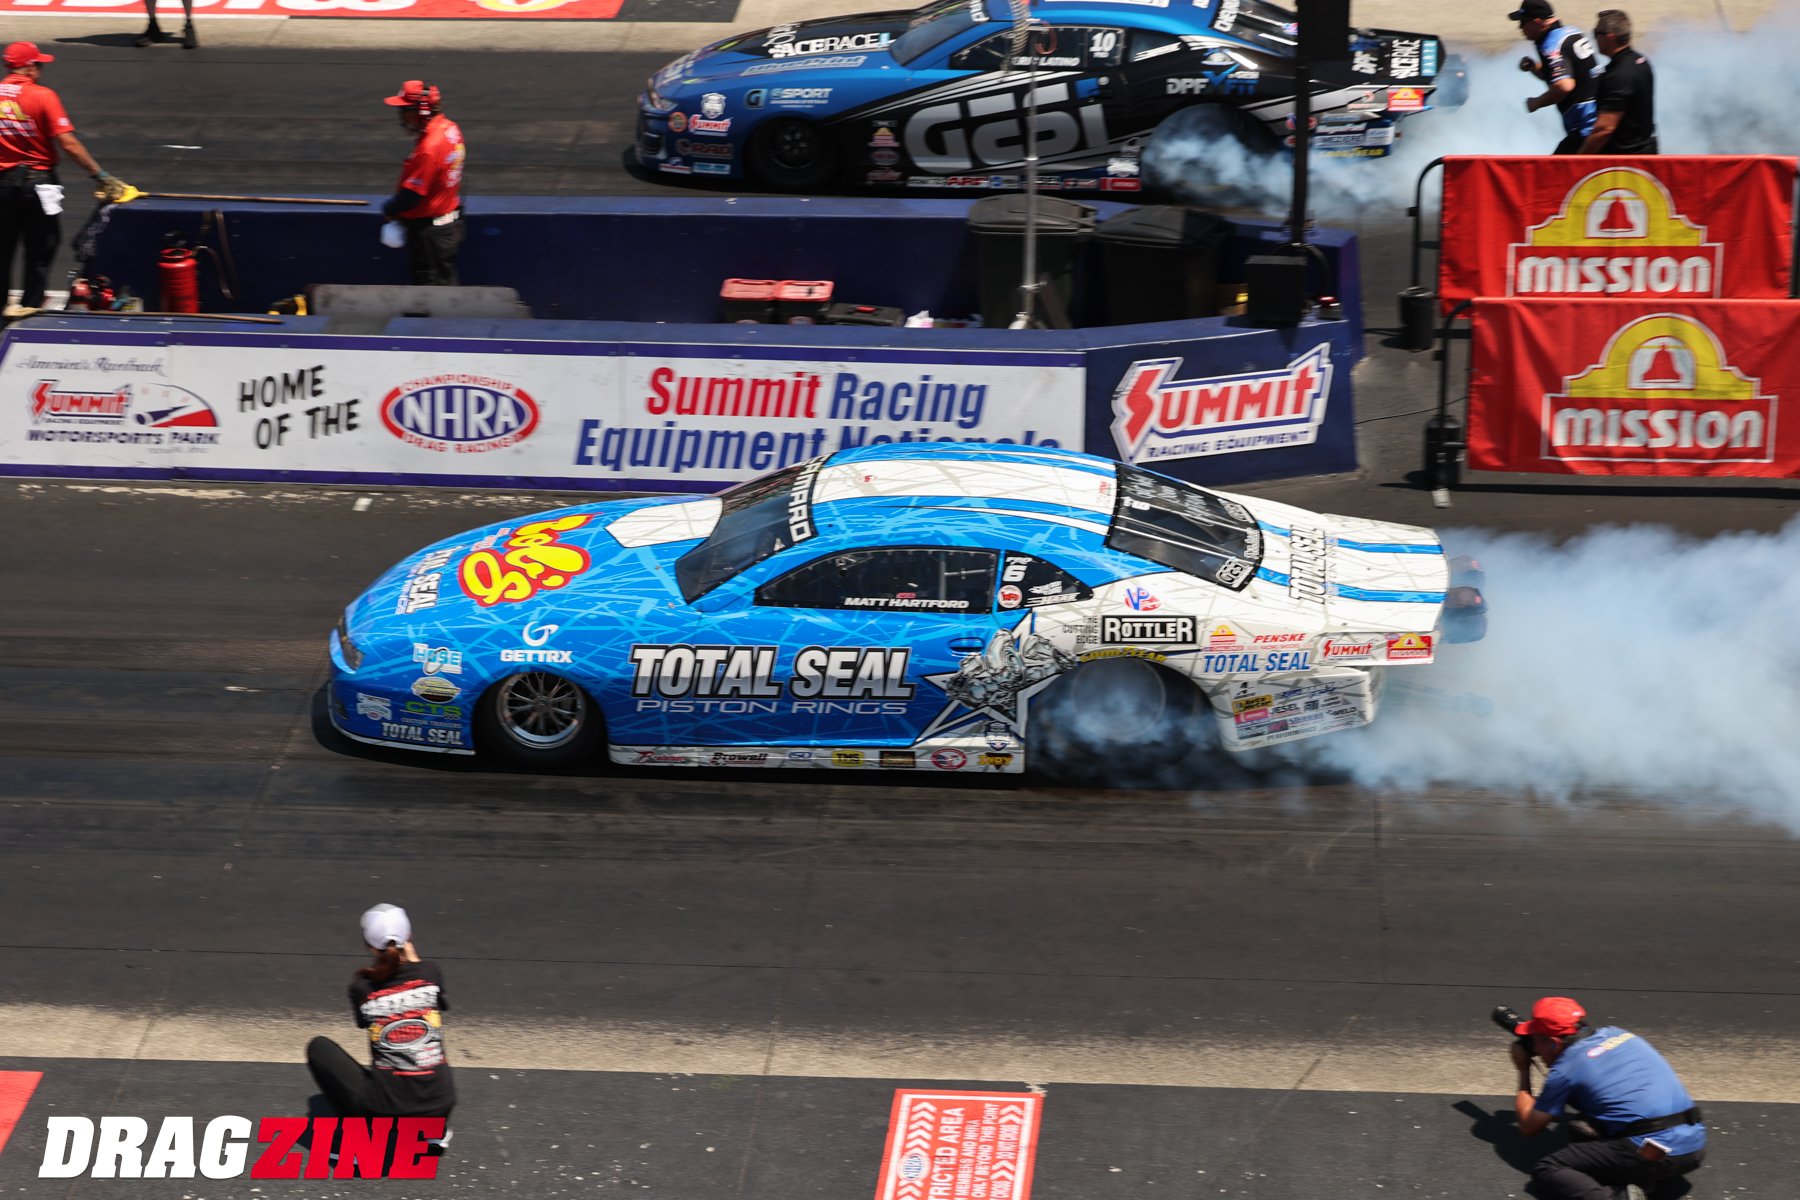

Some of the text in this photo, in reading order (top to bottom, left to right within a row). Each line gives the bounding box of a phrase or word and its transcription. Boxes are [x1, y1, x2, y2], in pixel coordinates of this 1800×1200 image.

[1089, 32, 1117, 52] 10
[1038, 57, 1081, 67] LATINO
[236, 364, 326, 413] HOME
[646, 366, 989, 429] Summit Racing
[254, 398, 361, 450] OF THE
[402, 388, 520, 439] NHRA
[26, 429, 220, 445] MOTORSPORTS PARK
[403, 434, 448, 453] DRAG
[575, 418, 828, 472] Equipment
[1147, 431, 1310, 458] RACING EQUIPMENT
[1002, 565, 1027, 582] 6
[844, 597, 970, 610] MATT HARTFORD
[1082, 614, 1099, 624] THE
[1103, 616, 1193, 643] ROTTLER
[1253, 633, 1307, 644] PENSKE
[500, 649, 574, 664] GETTRX
[1203, 652, 1310, 673] TOTAL SEAL
[633, 647, 914, 699] TOTAL SEAL
[405, 701, 462, 717] CTS
[637, 700, 907, 715] PISTON RINGS
[382, 722, 464, 746] TOTAL SEAL
[937, 1107, 966, 1144] AREA
[962, 1141, 978, 1157] AND
[971, 1102, 1000, 1198] ONLY BEYOND THIS POINT
[956, 1158, 975, 1196] MEMBERS
